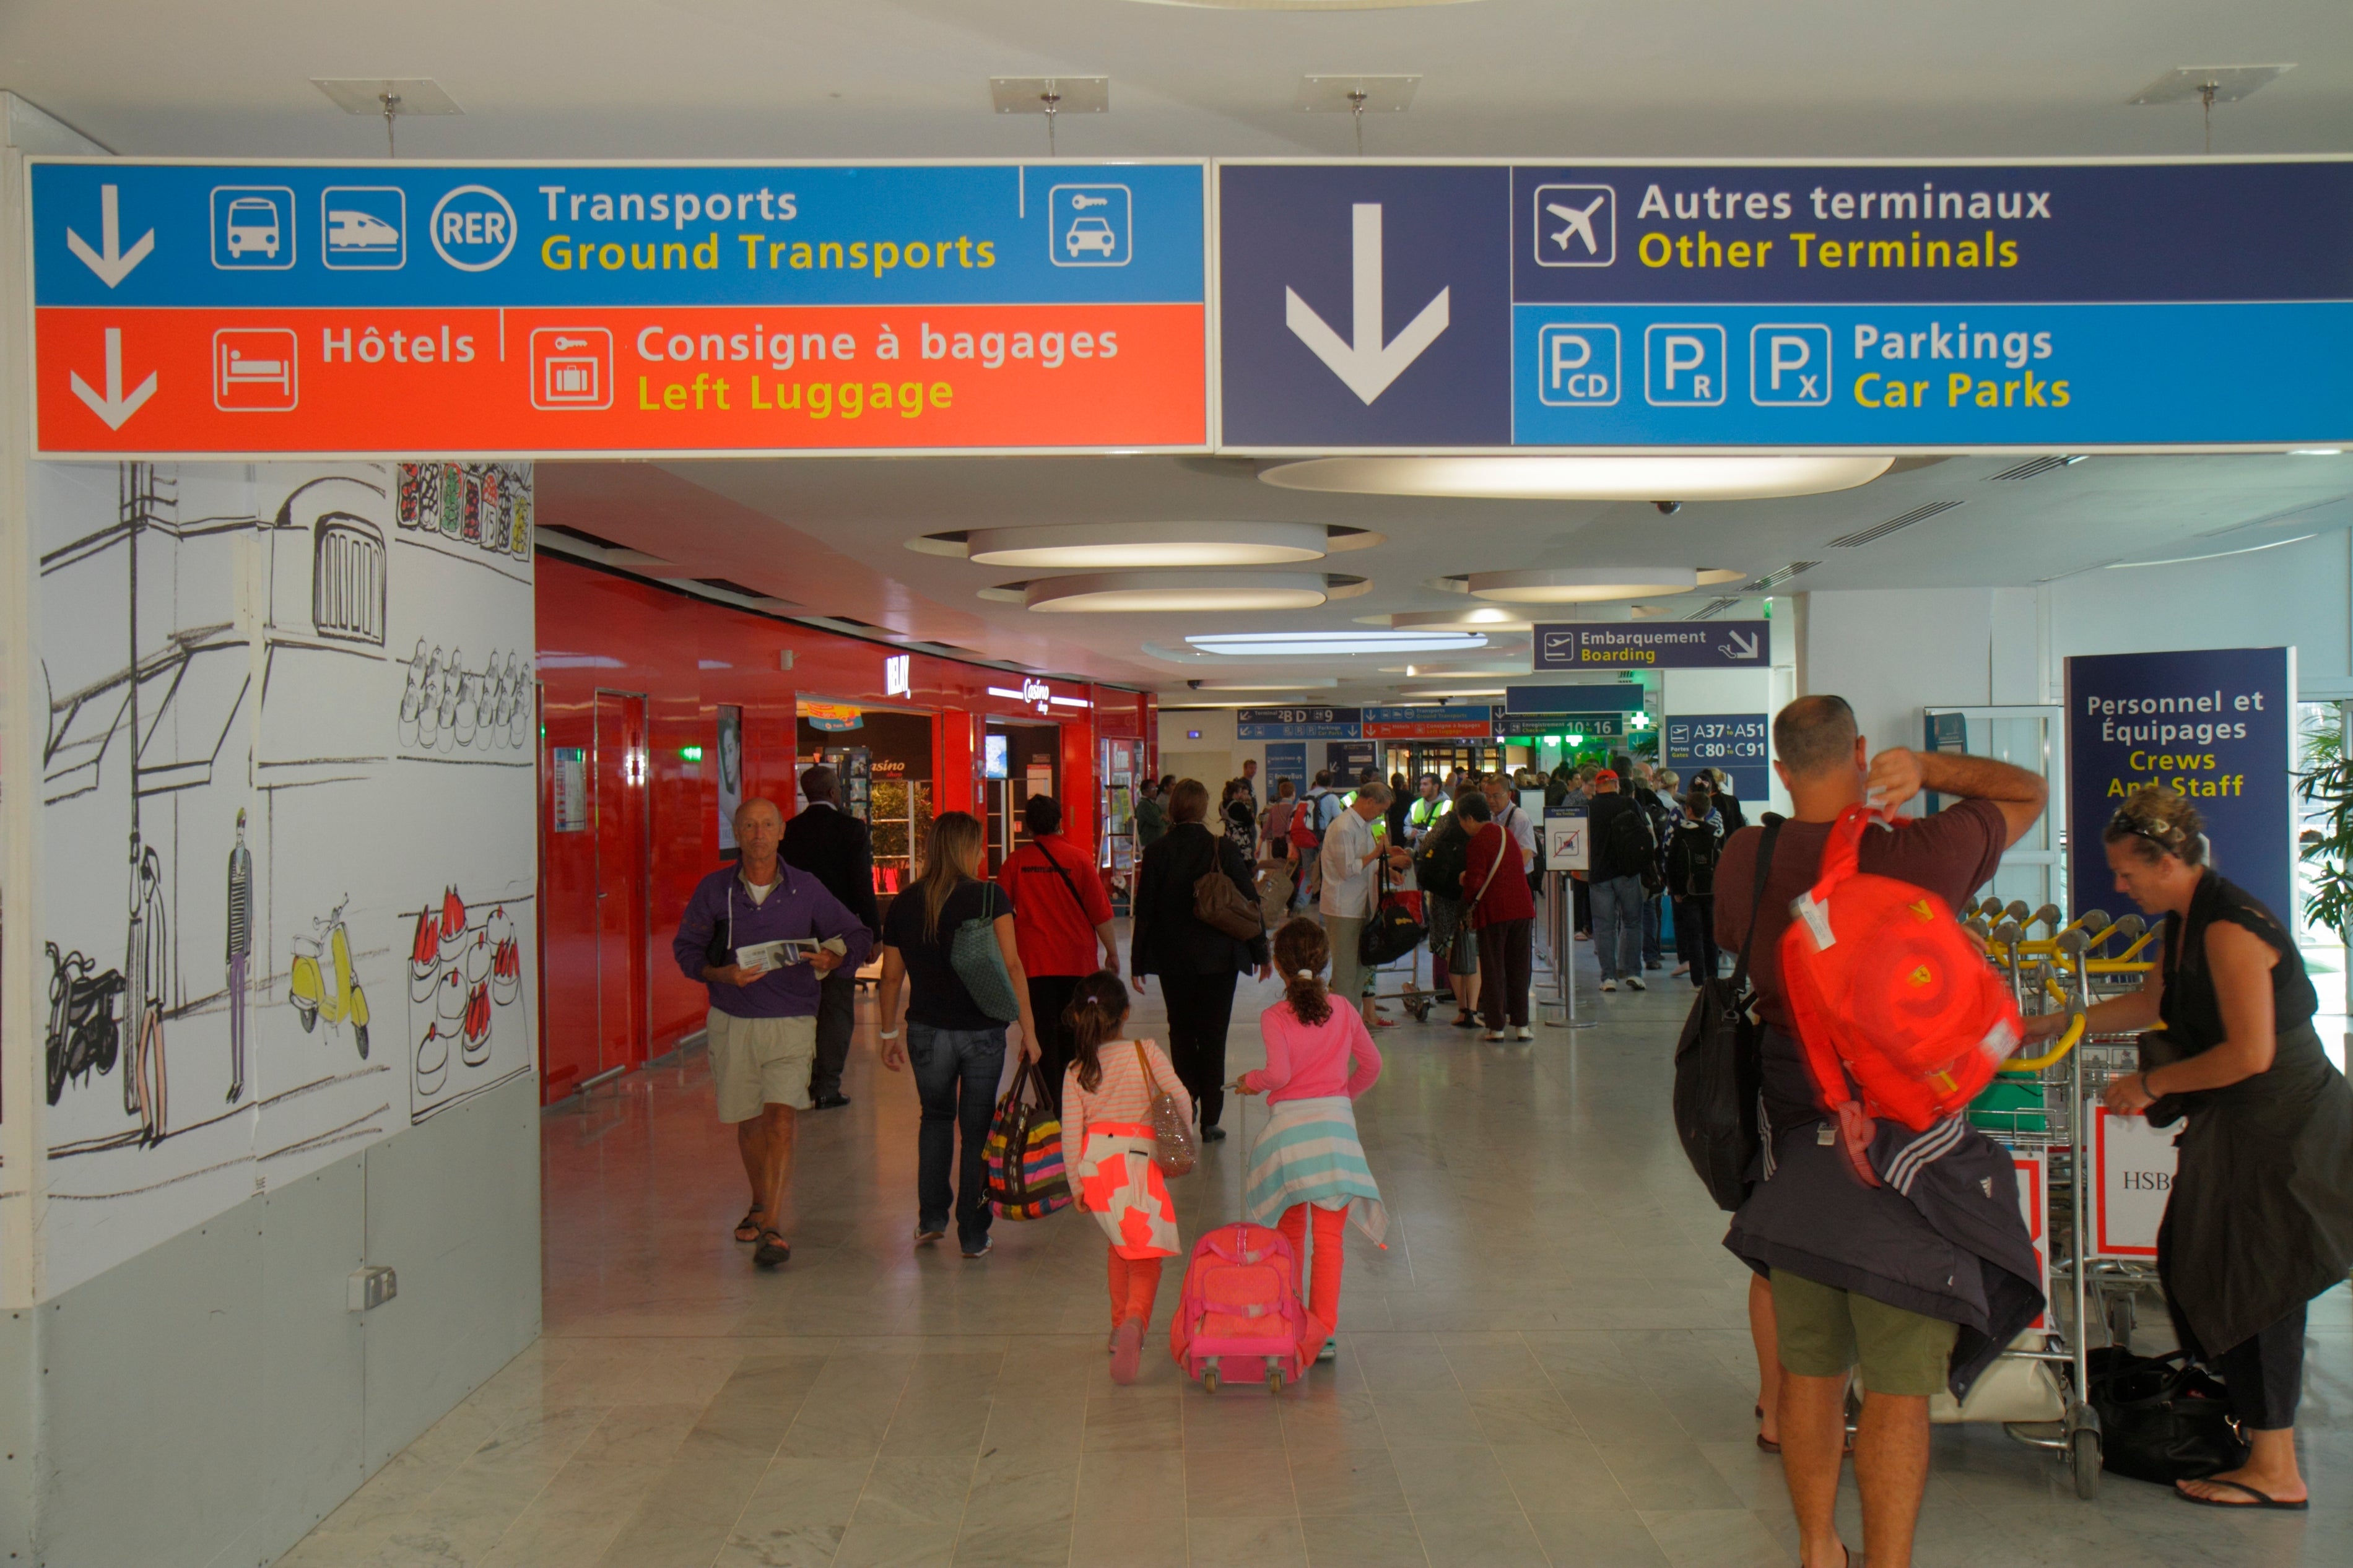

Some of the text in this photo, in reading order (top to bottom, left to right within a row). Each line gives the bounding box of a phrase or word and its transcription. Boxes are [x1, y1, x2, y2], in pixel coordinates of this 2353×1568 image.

[539, 186, 798, 230] Transports
[1637, 183, 2051, 219] Autres terminaux
[443, 211, 506, 245] RER
[541, 233, 996, 278] Ground Transports
[1638, 230, 2018, 268] Other Terminals
[322, 325, 476, 363] Hôtels
[637, 322, 1119, 373] Consigne à bagages
[1855, 322, 2053, 369] Parkings
[638, 375, 954, 419] Left Luggage
[1854, 368, 2071, 408] Car Parks
[1581, 630, 1707, 647] Embarquement
[1581, 647, 1656, 664] Boarding
[1024, 678, 1049, 703] Casino
[1037, 701, 1048, 715] shop
[1324, 709, 1334, 722] 9
[2088, 691, 2264, 716] Personnel et
[1295, 711, 1307, 723] D
[1567, 721, 1585, 734] 10
[1594, 721, 1612, 734] 16
[1694, 724, 1725, 739] A37
[1734, 723, 1764, 738] A51
[2102, 717, 2247, 747] Équipages
[1694, 743, 1725, 758] C80
[1734, 742, 1764, 757] C91
[2129, 750, 2216, 771] Crews
[871, 759, 905, 771] asino
[2172, 774, 2244, 797] Staff
[2123, 1170, 2174, 1192] HSB
